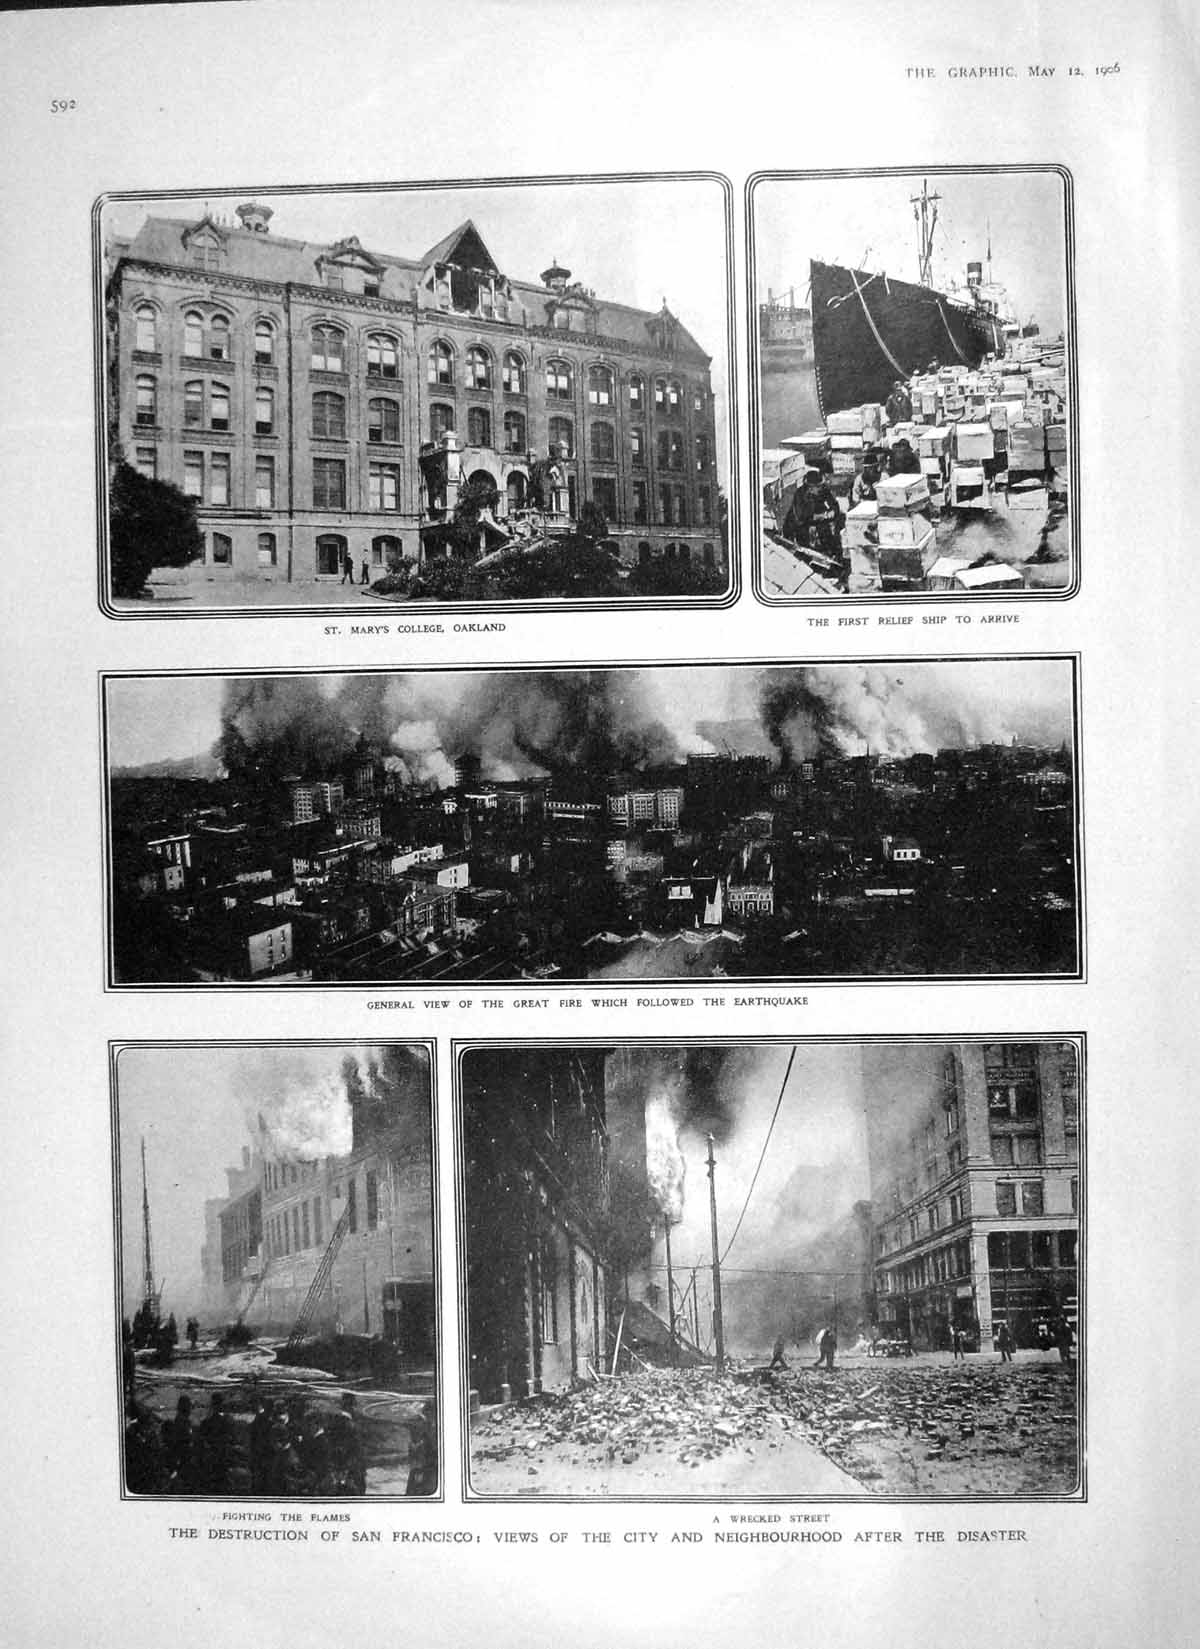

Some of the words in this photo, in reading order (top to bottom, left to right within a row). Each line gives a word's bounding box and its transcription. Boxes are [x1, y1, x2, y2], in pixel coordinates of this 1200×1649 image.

[906, 67, 936, 79] THE
[1096, 62, 1120, 77] 1906
[50, 99, 76, 113] 592
[807, 617, 830, 627] THE
[838, 616, 869, 626] FIRST
[878, 616, 914, 625] RELIEF
[922, 615, 947, 625] SHIP
[955, 615, 971, 624] TO
[980, 614, 1020, 624] ARRIVE
[324, 626, 342, 636] ST.
[351, 625, 390, 635] MARY'S
[453, 623, 507, 633] OAKLAND
[366, 1000, 415, 1010] GENERAL
[423, 999, 451, 1009] VIEW
[458, 999, 473, 1009] OF
[481, 999, 504, 1009] THE
[512, 999, 550, 1009] GREAT
[559, 999, 583, 1008] FIRE
[591, 998, 628, 1008] WHICH
[636, 998, 694, 1008] FOLLOWED
[702, 997, 726, 1007] THE
[733, 996, 809, 1008] EARTHQUAKE
[222, 1511, 272, 1522] FIGHTING
[280, 1512, 303, 1522] THE
[310, 1513, 351, 1523] FLAMES
[713, 1515, 720, 1524] A
[730, 1514, 782, 1524] WRECKED
[790, 1514, 831, 1524] STREET
[168, 1527, 200, 1540] THE
[208, 1528, 308, 1542] DESTRUCTION
[320, 1530, 340, 1542] OF
[352, 1531, 381, 1543] SAN
[494, 1532, 539, 1544] VIEWS
[550, 1532, 569, 1544] OF
[582, 1532, 612, 1544] THE
[624, 1532, 659, 1544] CITY
[671, 1531, 703, 1543] AND
[714, 1531, 843, 1544] NEIGHBOURHOOD
[854, 1531, 902, 1543] AFTER
[915, 1531, 945, 1543] THE
[957, 1529, 1028, 1543] DISASTER
